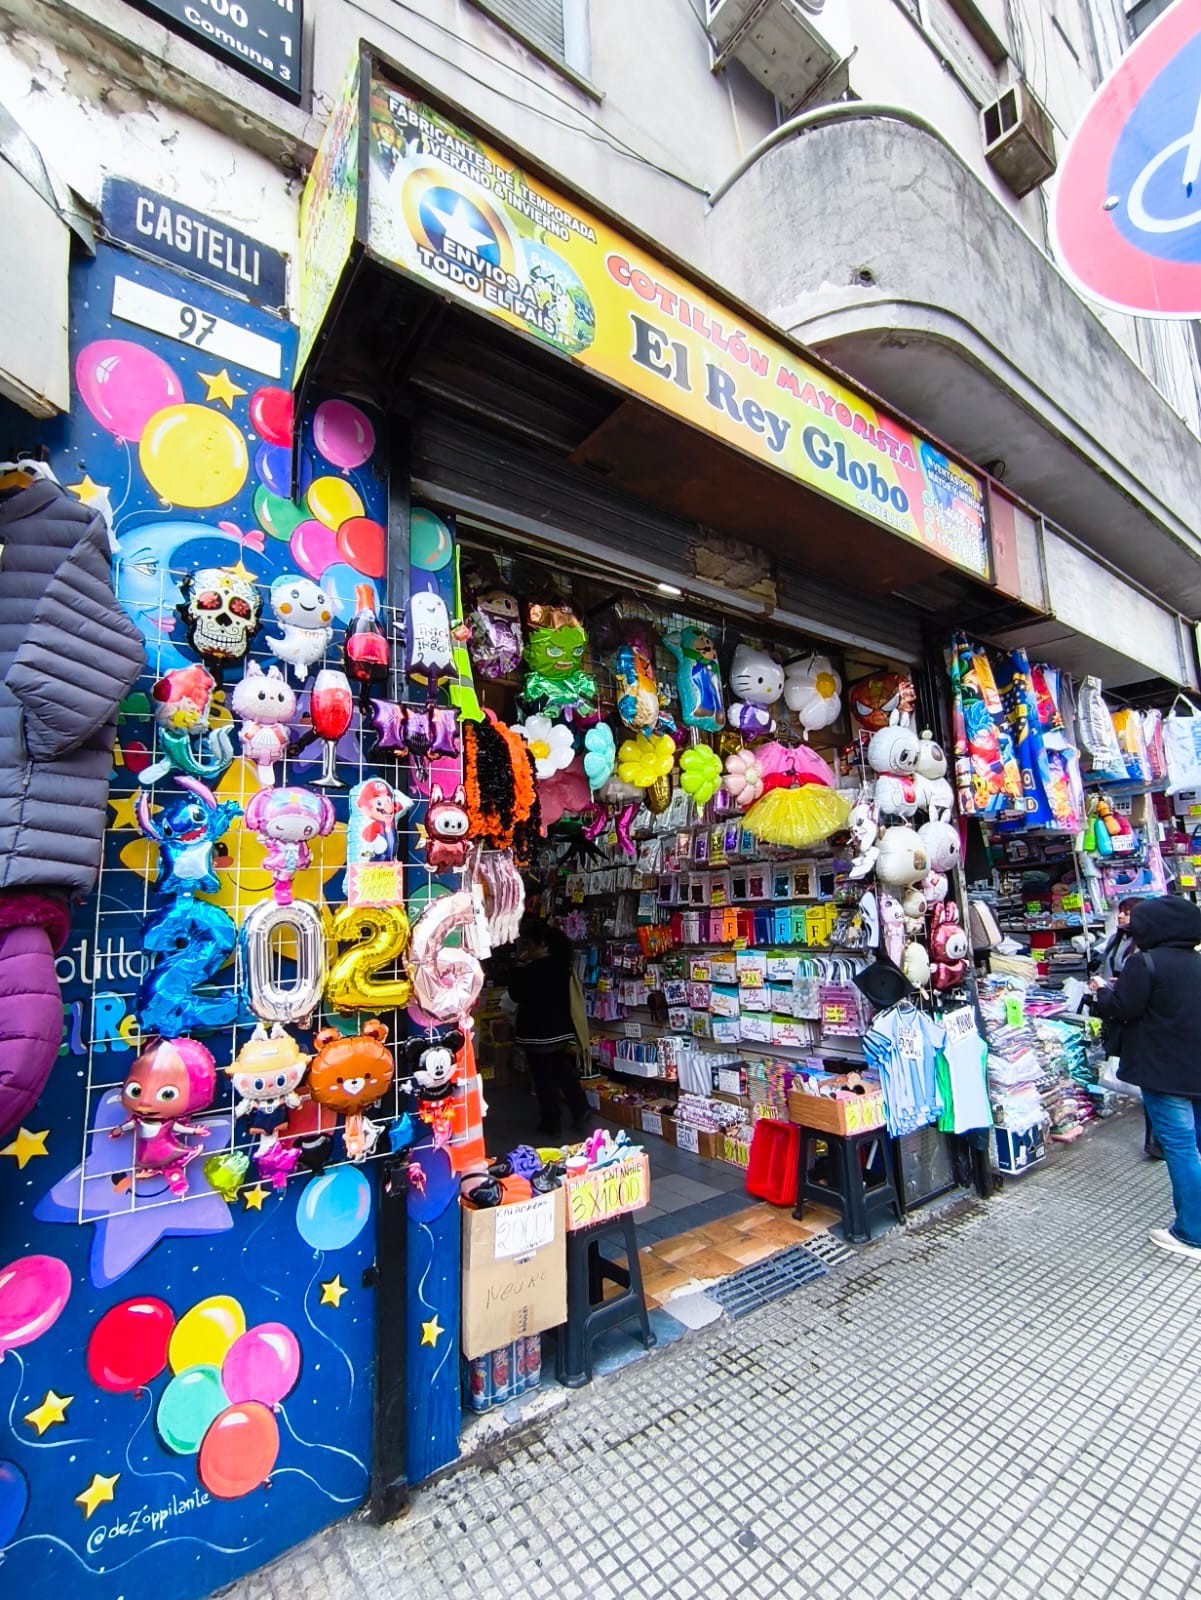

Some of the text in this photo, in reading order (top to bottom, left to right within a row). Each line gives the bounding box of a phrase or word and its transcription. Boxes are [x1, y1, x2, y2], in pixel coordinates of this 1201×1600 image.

[184, 6, 291, 80] Comuna 3
[200, 0, 248, 28] 00
[280, 35, 292, 57] 1
[388, 96, 598, 244] FABRICANTES DE TEMPORADA
[430, 142, 569, 242] VERANO & INVIERNO
[136, 196, 260, 286] CASTELLI
[442, 236, 539, 307] ENVIOS A
[178, 306, 217, 345] 97
[417, 245, 556, 336] TODO EL PAÍS
[606, 254, 916, 471] COTILLÓN MAYORISTA
[630, 313, 909, 514] El Rey Globo
[93, 991, 148, 1053] Re
[86, 1488, 211, 1554] @deZoppilante
